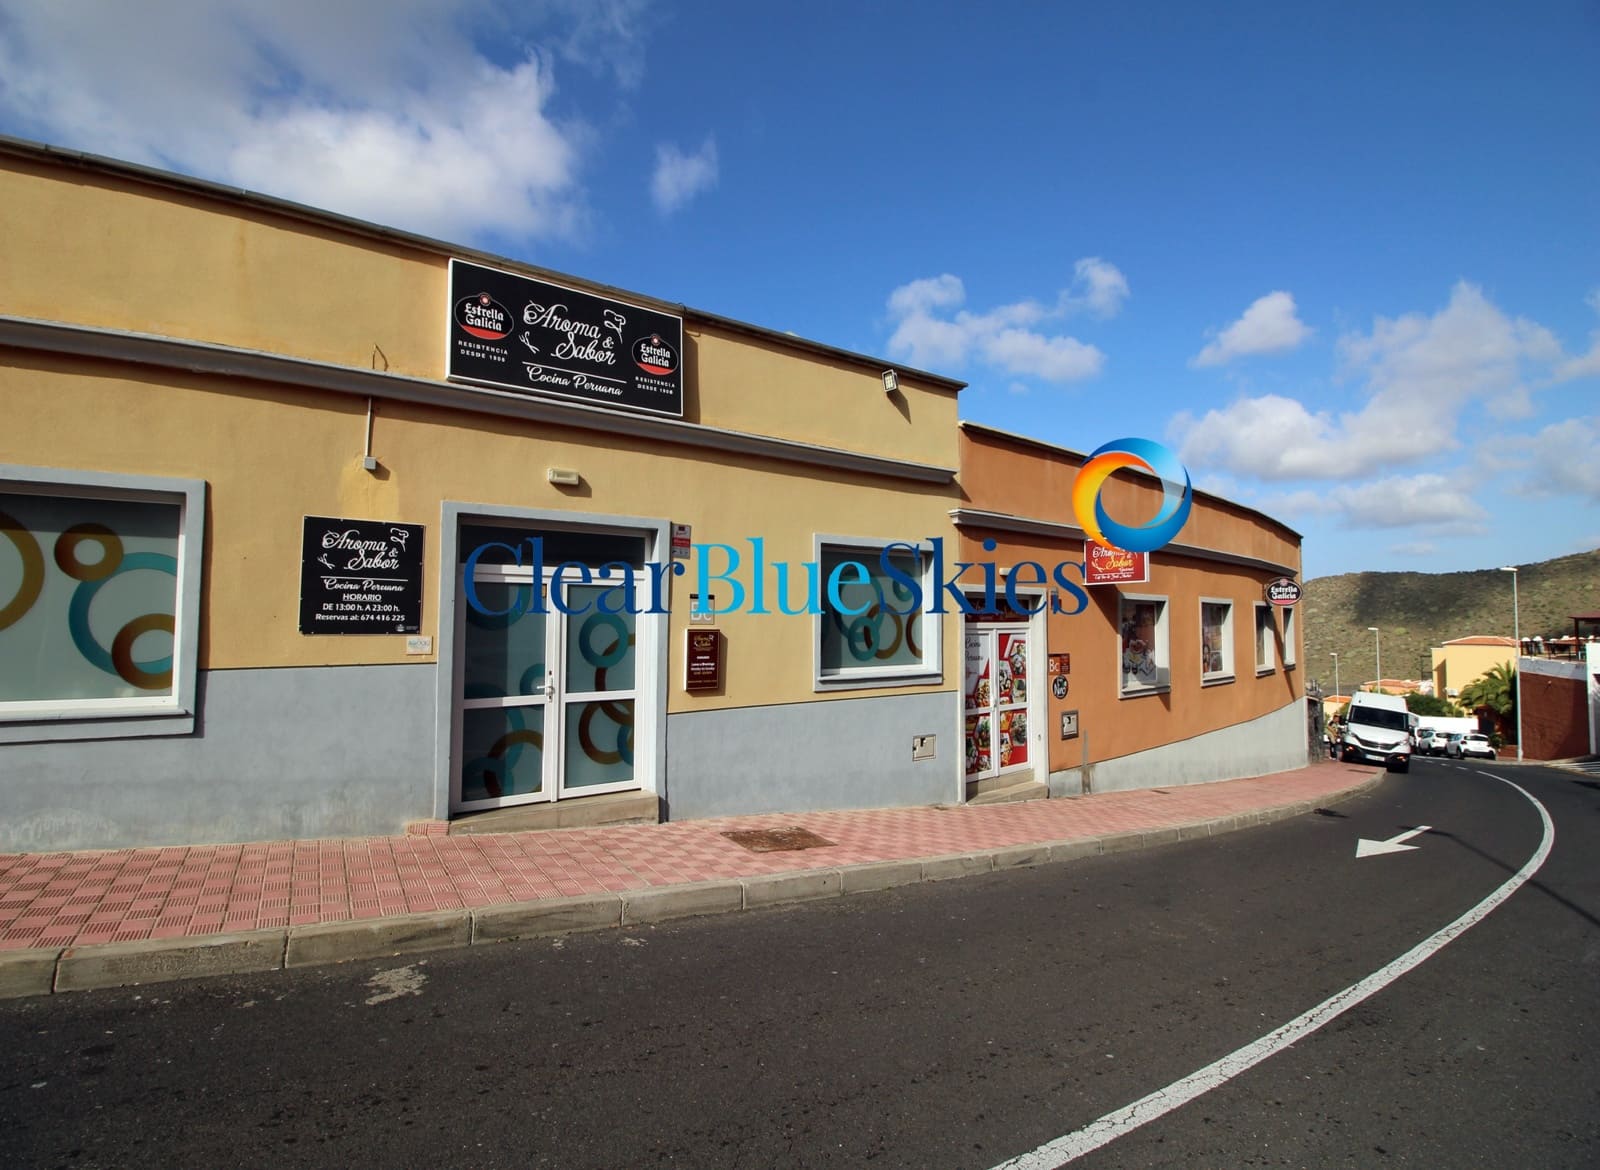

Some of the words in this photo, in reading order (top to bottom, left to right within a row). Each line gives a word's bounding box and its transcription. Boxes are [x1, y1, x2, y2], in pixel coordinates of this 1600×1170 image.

[464, 302, 504, 321] Estrella
[465, 313, 502, 332] Galicia
[523, 300, 601, 339] Aroma
[602, 336, 615, 349] &
[458, 340, 508, 355] RESISTENCIA
[460, 349, 486, 359] DESDE
[551, 332, 616, 365] Sabor
[640, 343, 670, 359] Estrella
[641, 352, 669, 368] Galicia
[526, 365, 571, 387] Cocina
[572, 375, 623, 396] Peruana
[322, 529, 388, 550] Aroma
[388, 547, 399, 558] &
[344, 548, 400, 571] Sabor
[323, 578, 360, 590] Cocina
[362, 580, 405, 592] Peruana
[342, 593, 382, 601] HORARIO
[322, 603, 334, 611] DE
[335, 603, 355, 611] 13:00
[372, 604, 392, 612] 23:00
[315, 613, 348, 621] Reservas
[391, 614, 405, 622] 225
